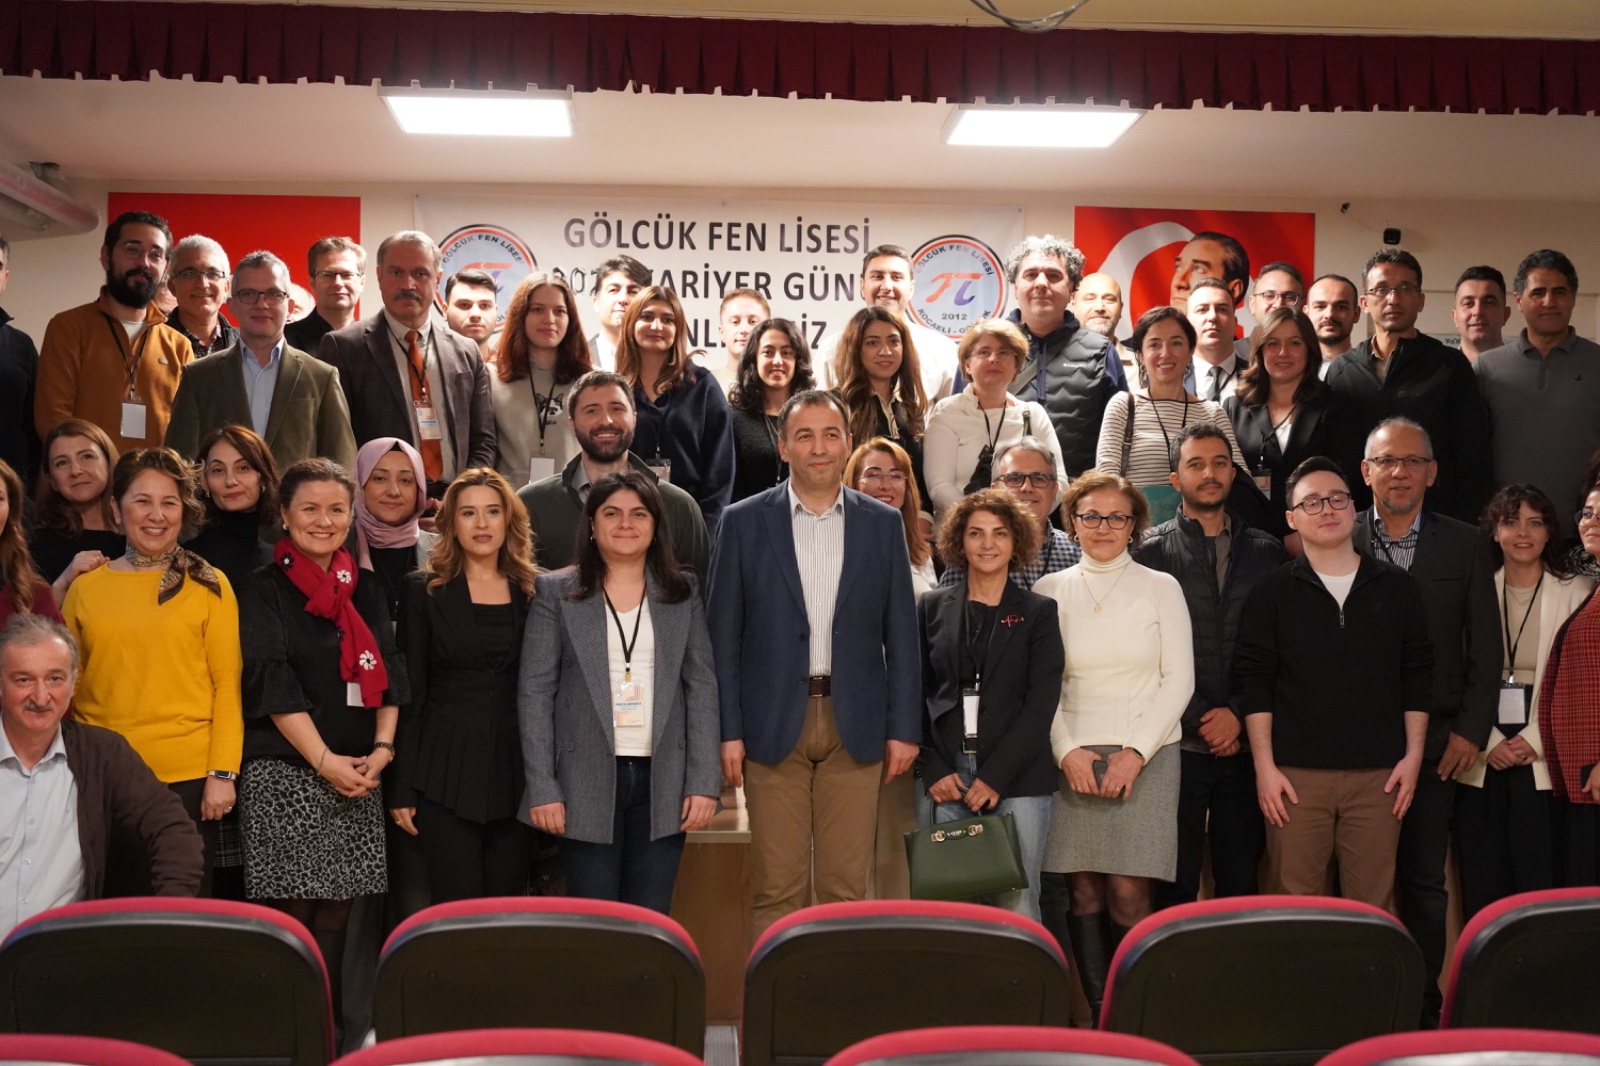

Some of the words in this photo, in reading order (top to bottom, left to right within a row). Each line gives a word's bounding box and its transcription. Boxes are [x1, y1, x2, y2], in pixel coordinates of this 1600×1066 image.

[478, 234, 499, 243] FEN
[564, 211, 697, 250] GÖLCÜK
[708, 222, 766, 252] FEN
[779, 216, 870, 254] LİSESİ
[650, 262, 772, 300] ARİYER
[783, 265, 865, 301] GÜN
